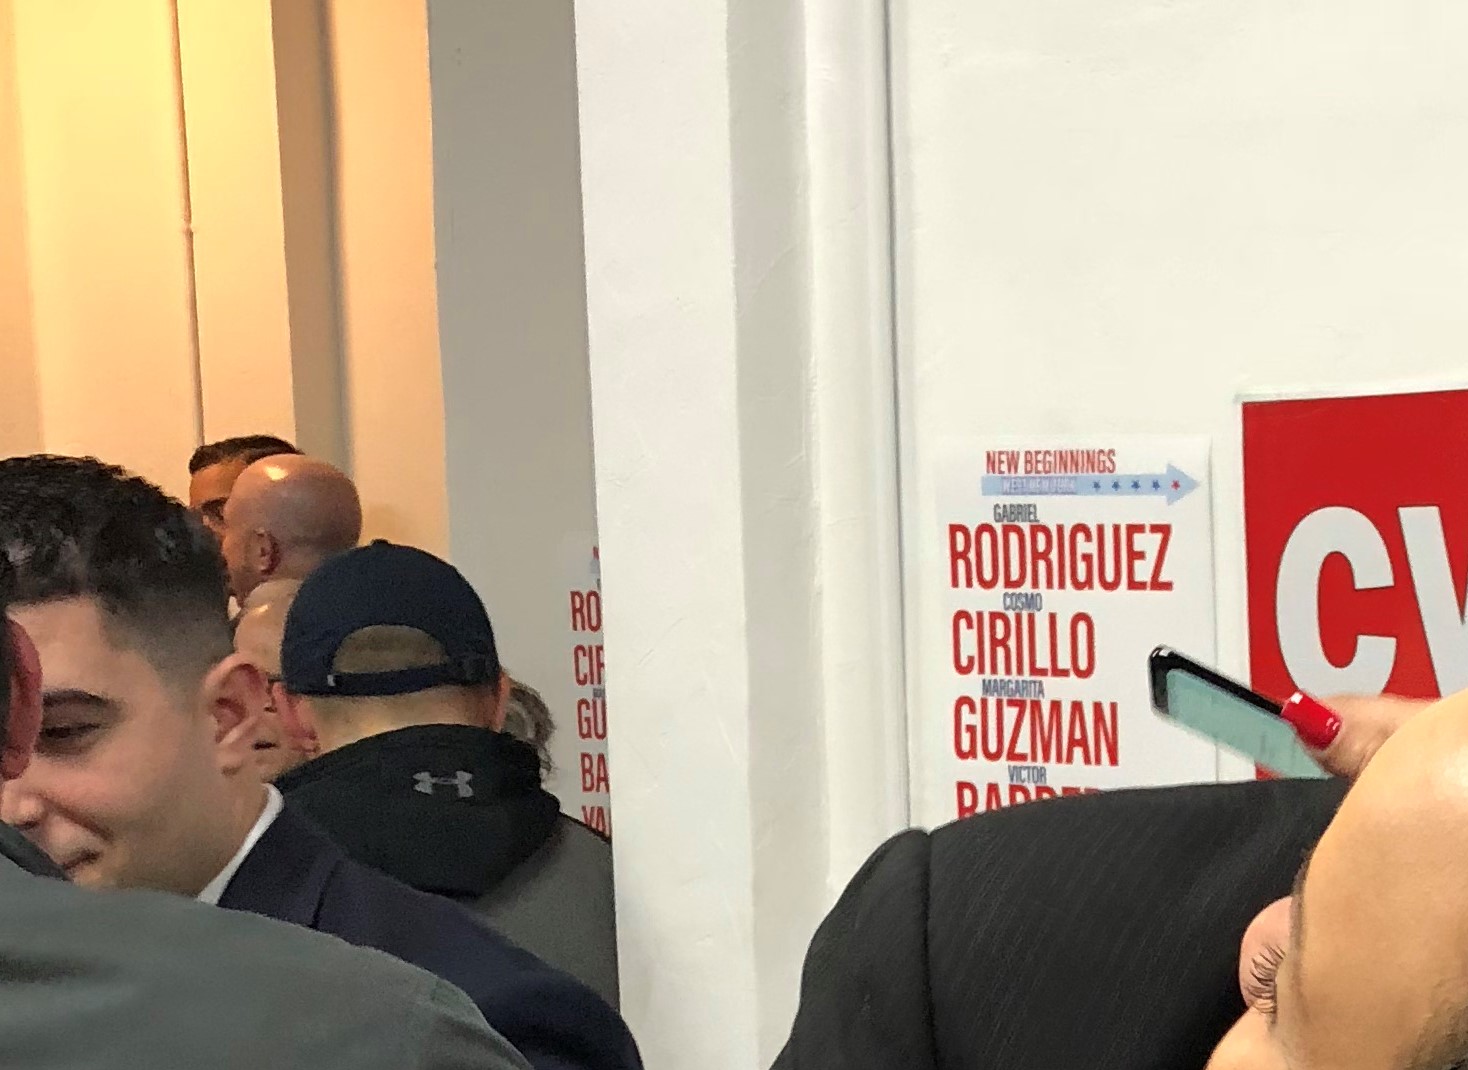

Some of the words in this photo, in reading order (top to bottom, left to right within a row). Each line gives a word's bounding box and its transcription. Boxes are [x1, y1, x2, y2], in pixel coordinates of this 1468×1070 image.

[986, 449, 1020, 475] NEW
[1024, 448, 1117, 475] BEGINNINGS
[993, 503, 1040, 523] GABRIEL
[948, 523, 1174, 591] RODRIGUEZ
[1002, 592, 1043, 612] COSMO
[952, 610, 1096, 679] CIRILLO
[982, 678, 1045, 699] MARGARITA
[953, 695, 1120, 767] GUZMAN
[1008, 765, 1047, 784] VICTOR
